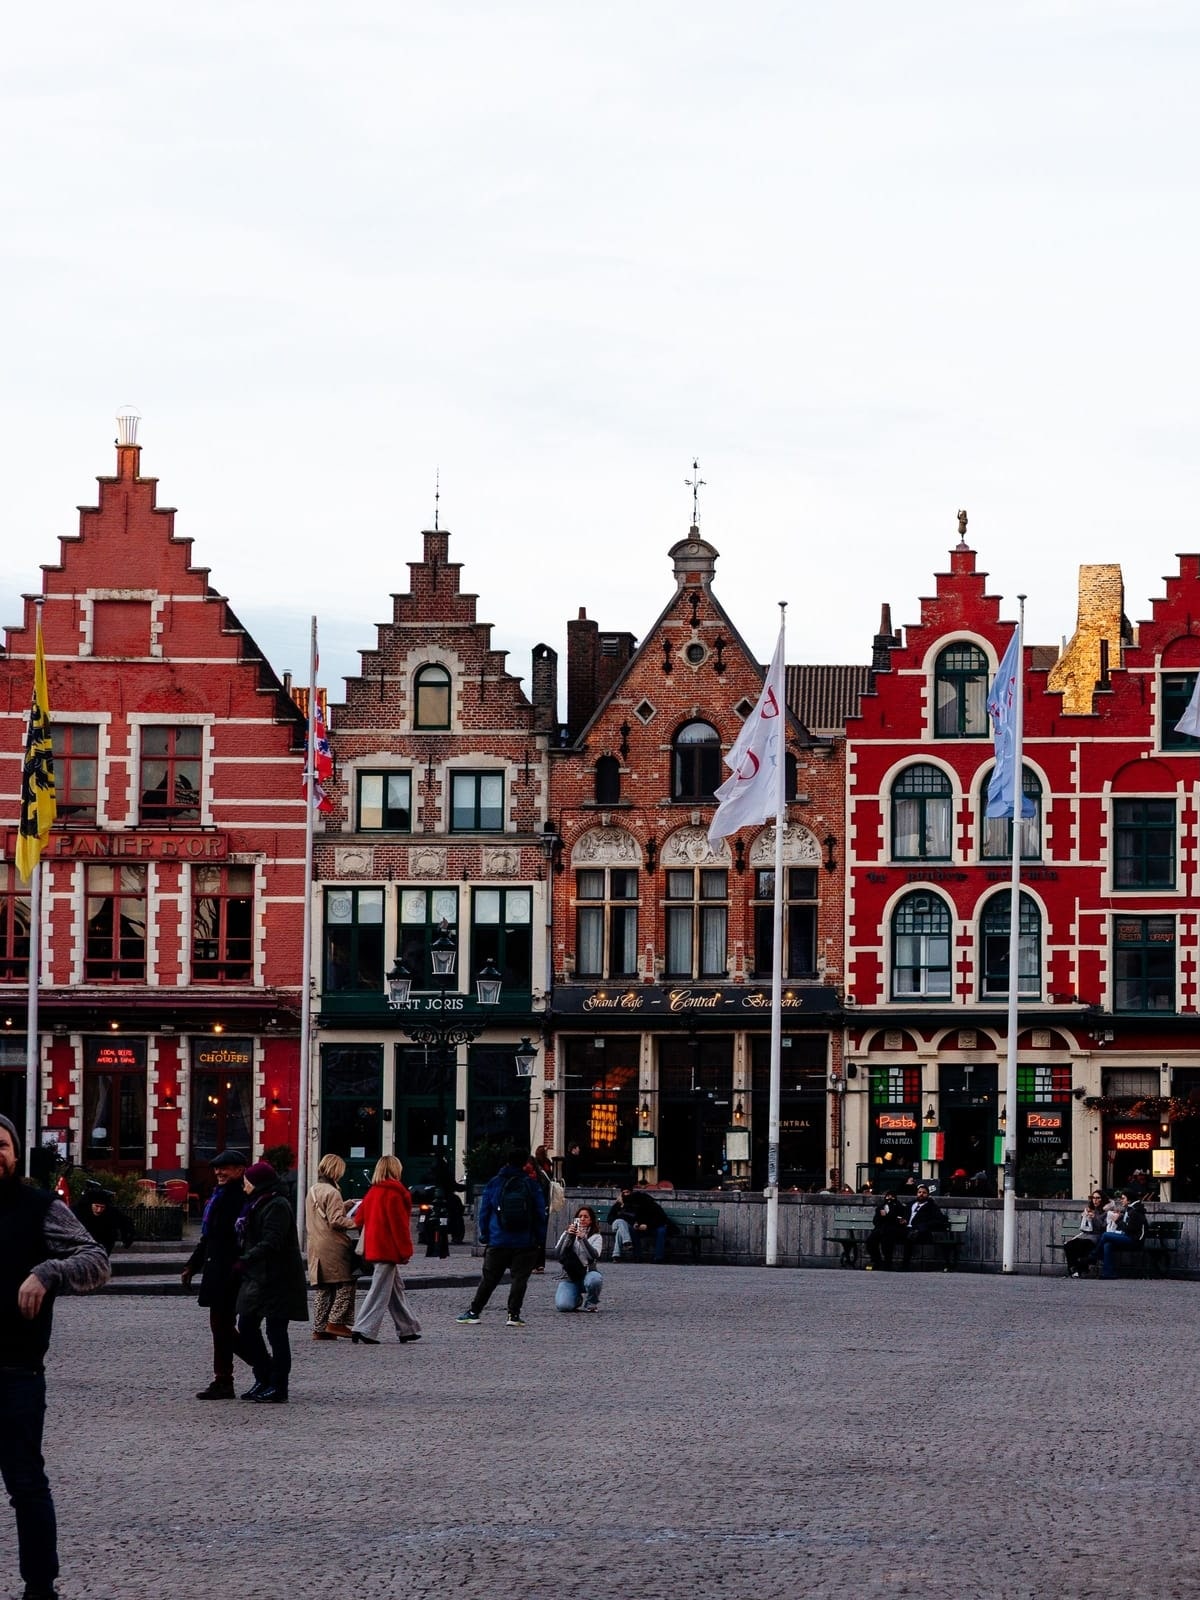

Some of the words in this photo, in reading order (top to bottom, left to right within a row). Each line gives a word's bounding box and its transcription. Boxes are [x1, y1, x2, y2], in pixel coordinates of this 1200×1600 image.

[425, 998, 464, 1010] JORIS
[582, 994, 619, 1012] Grand
[668, 989, 722, 1012] Central
[741, 993, 804, 1008] Braerie
[199, 1053, 249, 1063] CHOUFFE
[879, 1114, 914, 1129] Pasta
[1114, 1133, 1152, 1141] MUSSELS
[1116, 1141, 1150, 1149] MOULES
